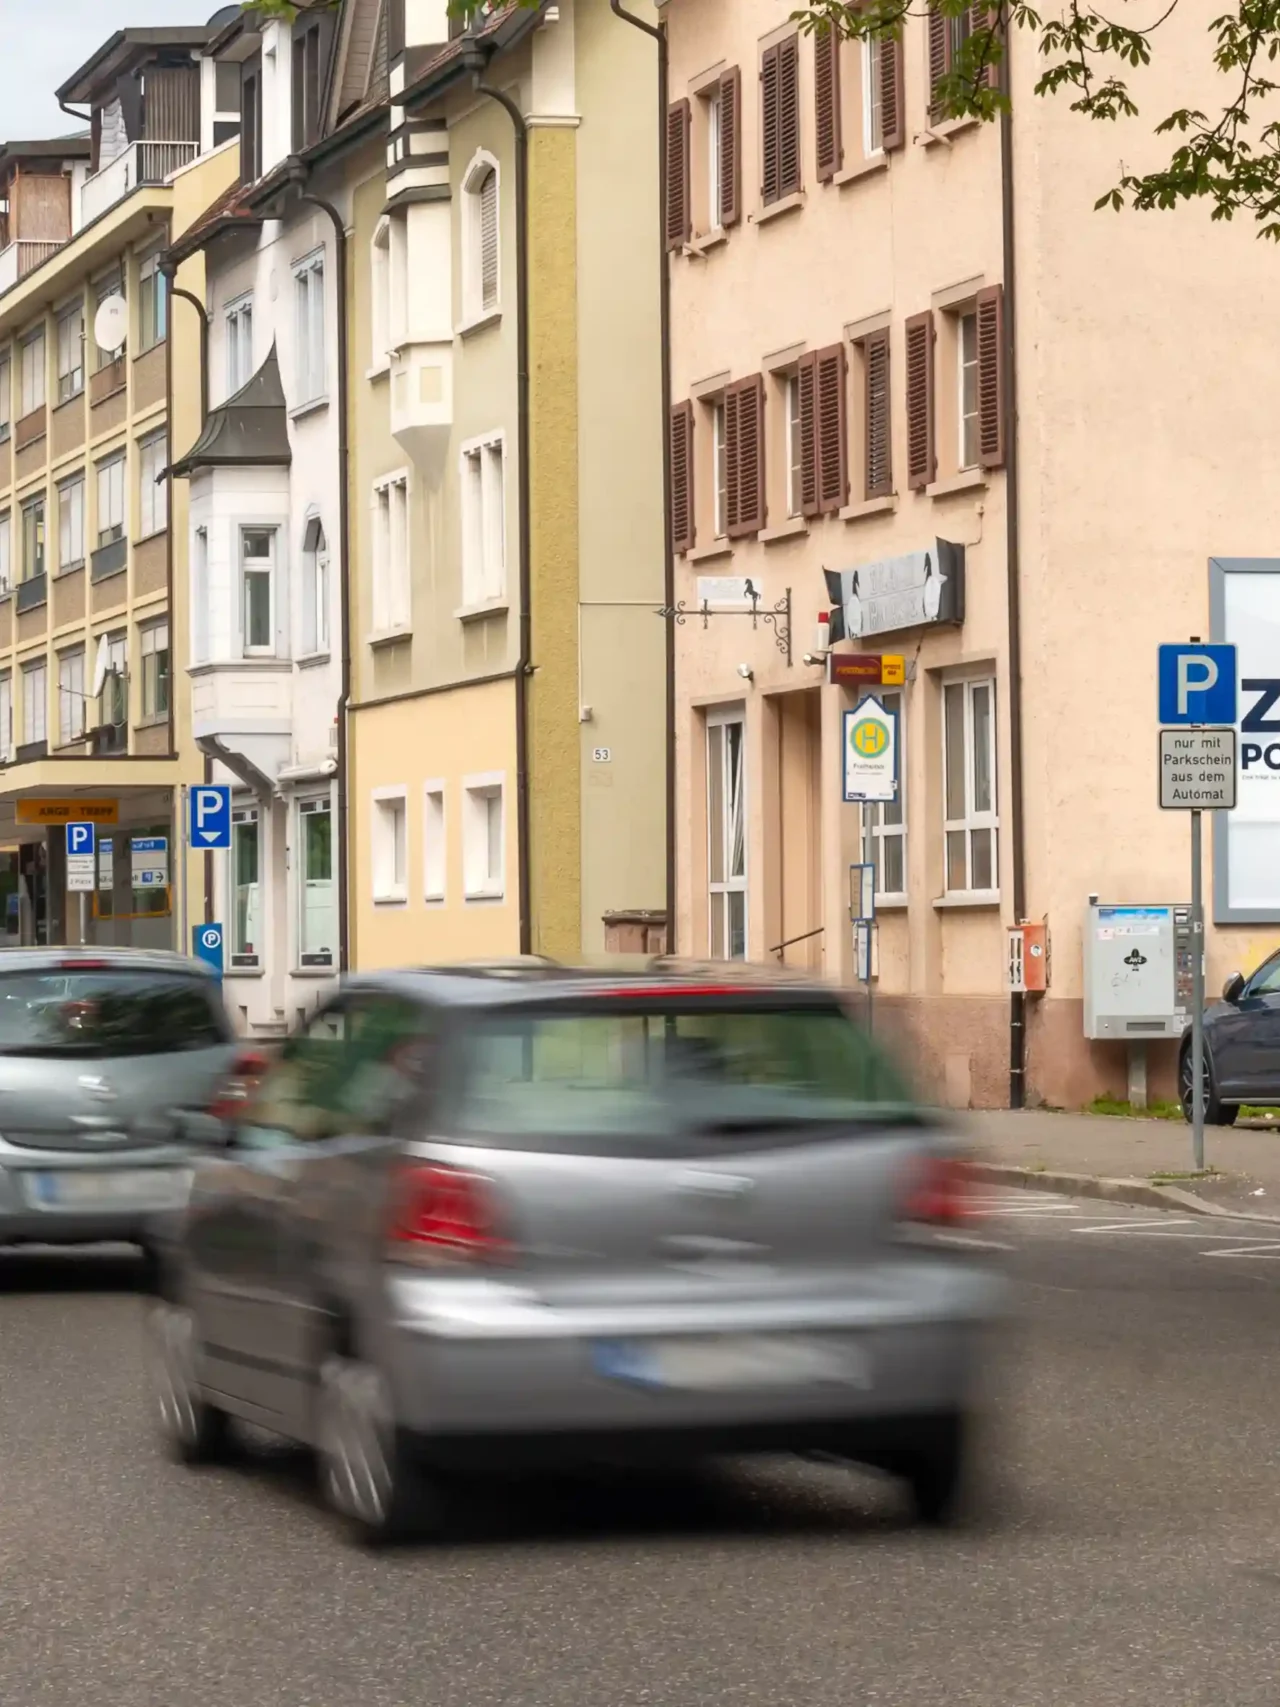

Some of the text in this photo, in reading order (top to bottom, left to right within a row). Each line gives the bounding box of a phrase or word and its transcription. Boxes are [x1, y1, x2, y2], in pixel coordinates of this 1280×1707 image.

[1177, 654, 1219, 715] P
[1174, 737, 1221, 749] nur mit
[595, 749, 609, 760] 53
[1164, 754, 1232, 766] Parkschein
[1171, 771, 1225, 782] aus dem
[1172, 788, 1224, 800] Automat
[197, 790, 224, 828] P
[72, 827, 88, 851] P
[207, 933, 216, 944] P
